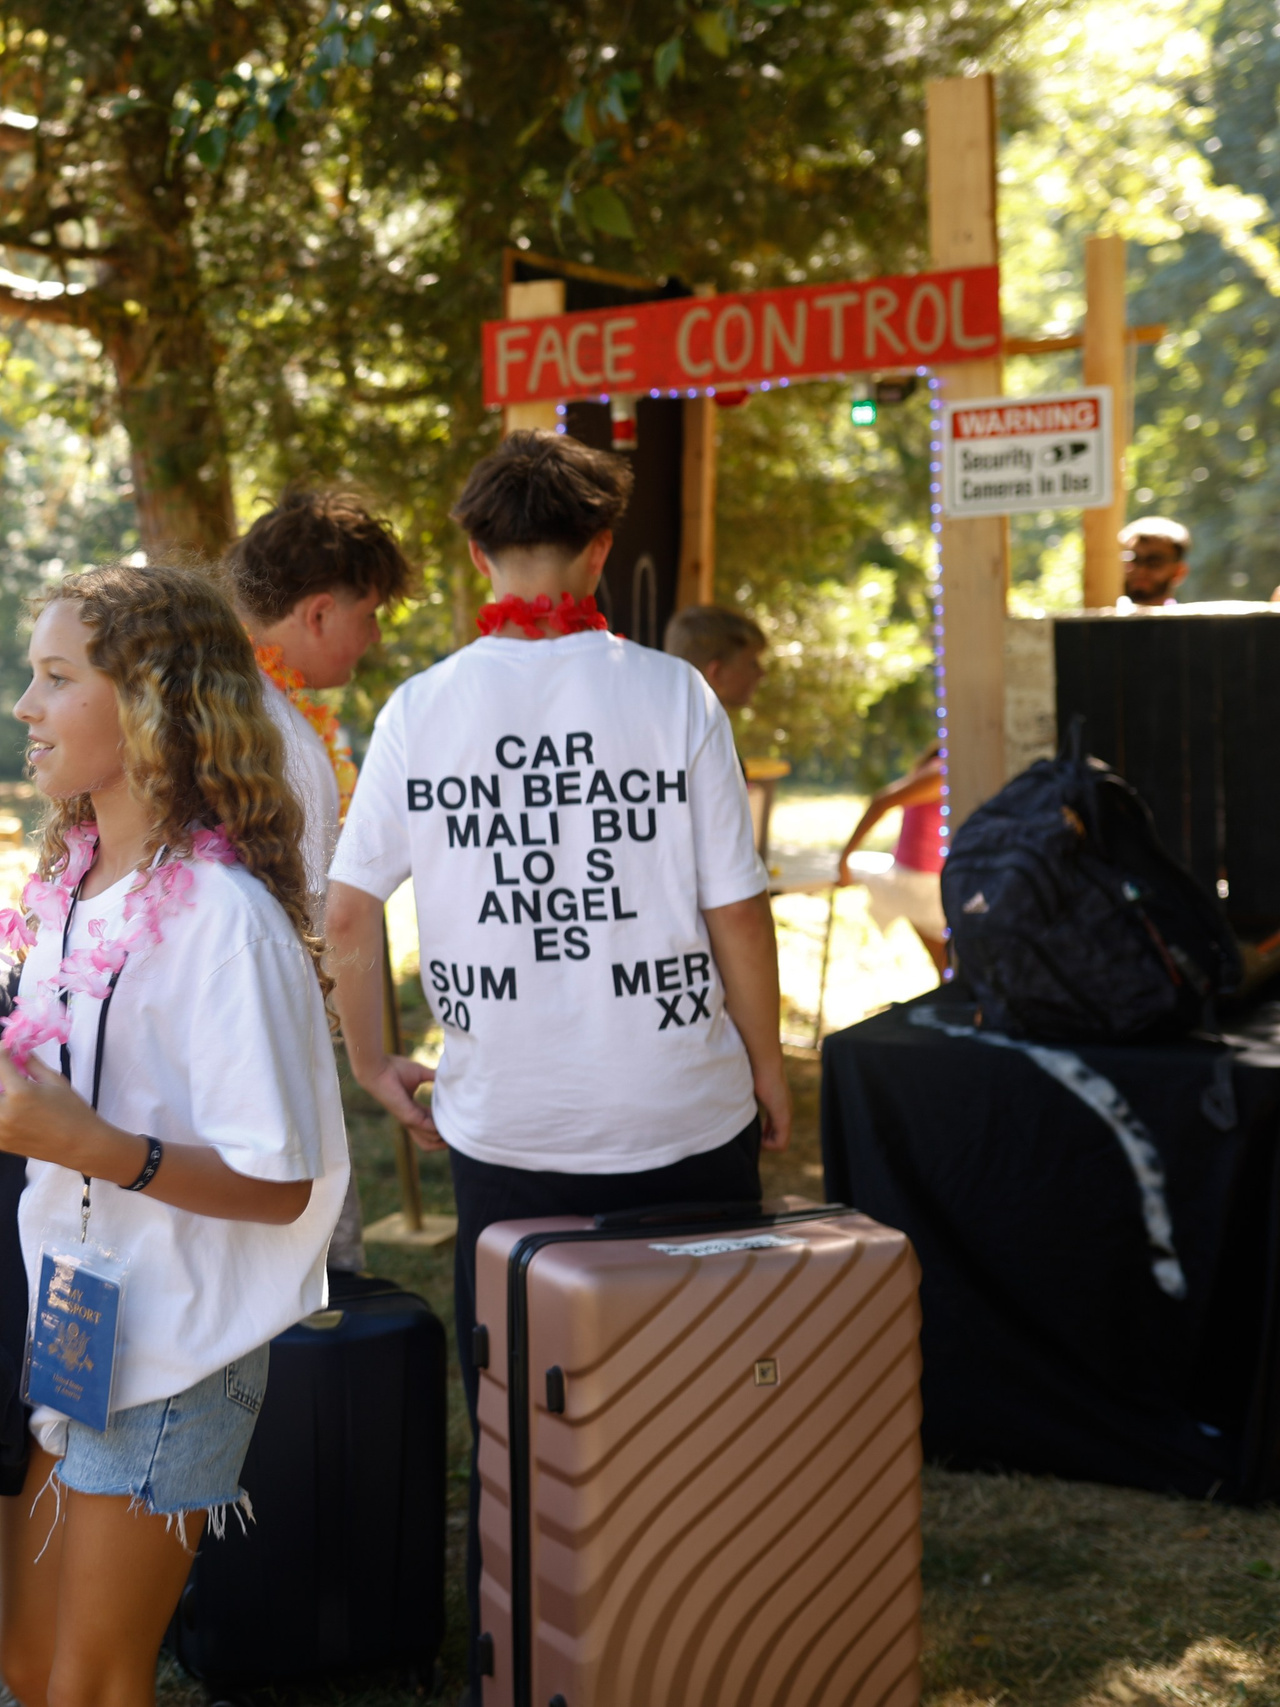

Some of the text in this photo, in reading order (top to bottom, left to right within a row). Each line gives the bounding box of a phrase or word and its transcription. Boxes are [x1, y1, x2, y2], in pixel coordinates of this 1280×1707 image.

[495, 278, 996, 397] FACE CONTROL
[957, 401, 1095, 437] WARNING
[961, 446, 1032, 472] Security
[962, 473, 1090, 500] Cameras In Use
[495, 731, 595, 770] CAR
[407, 768, 688, 811] BON BEACH
[446, 807, 657, 848] MALI BU
[493, 848, 615, 886] LO S
[477, 886, 638, 925] ANGEL
[533, 926, 591, 962] ES
[429, 952, 711, 1001] SUM MER
[438, 986, 712, 1033] 20 XX
